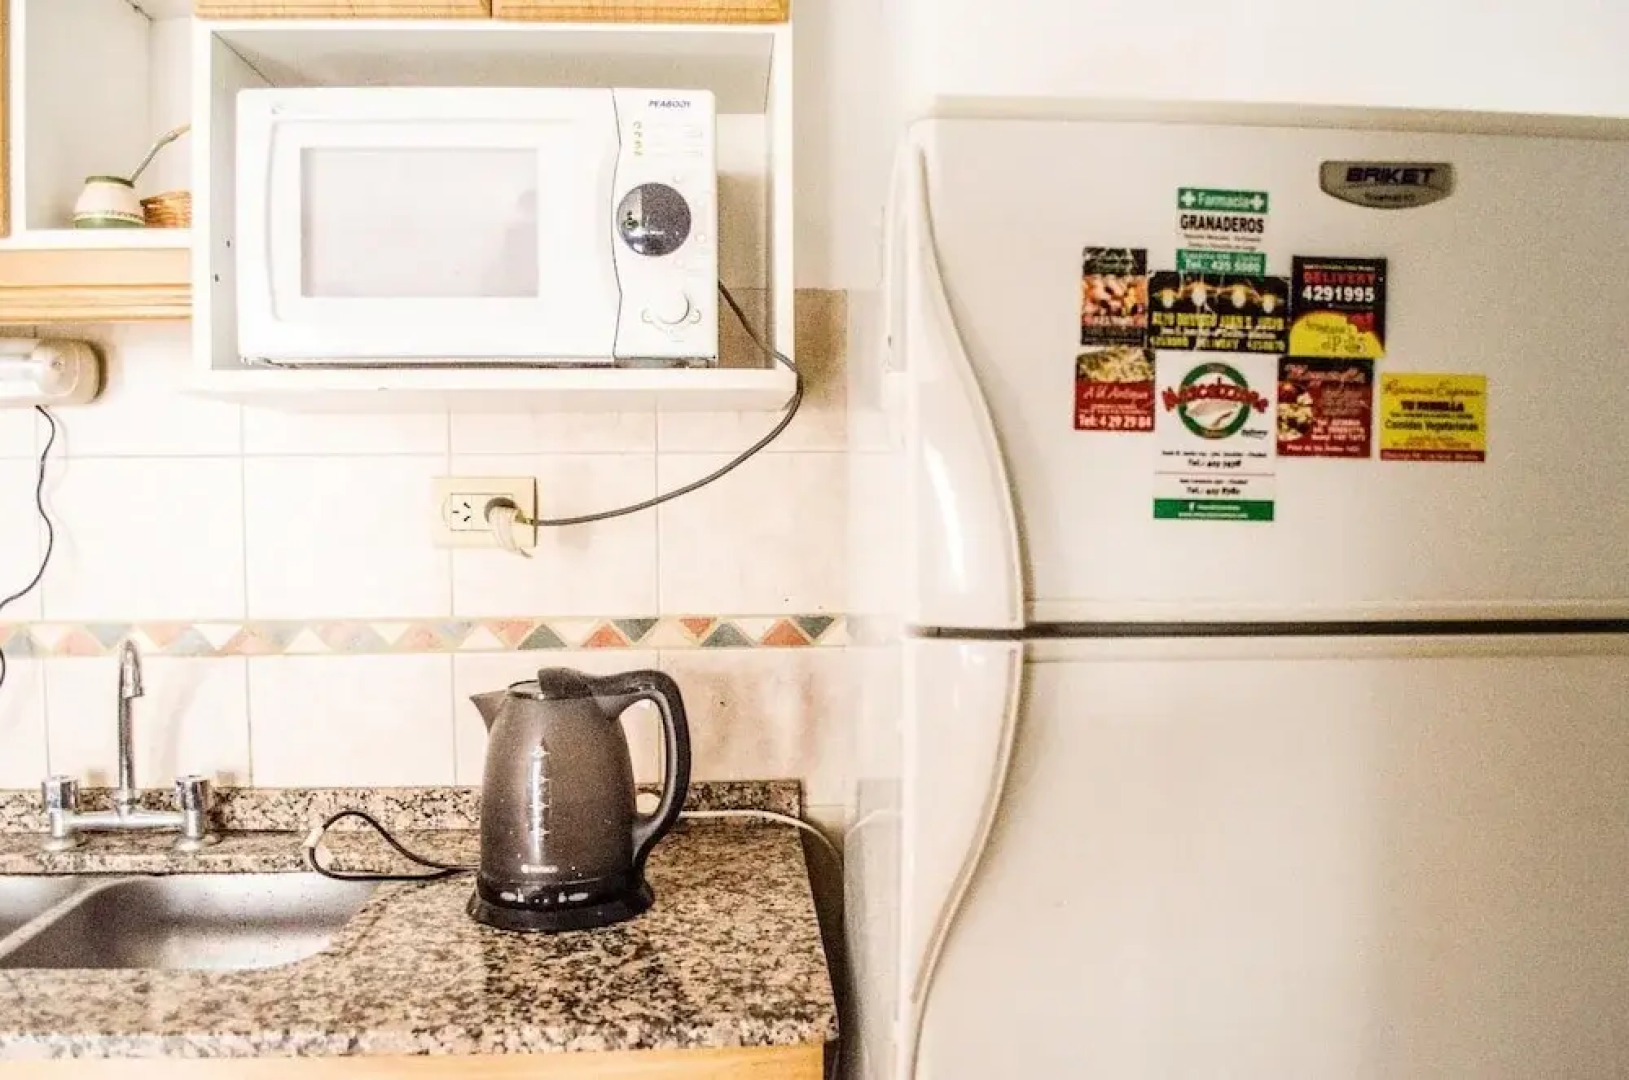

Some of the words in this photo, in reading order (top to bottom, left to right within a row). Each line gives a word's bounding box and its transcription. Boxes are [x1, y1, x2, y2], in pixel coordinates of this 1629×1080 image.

[1346, 167, 1436, 185] BRIKET
[1198, 191, 1249, 208] Farmacia
[1180, 214, 1264, 233] GRANADEROS
[1303, 271, 1376, 286] DELIVERY
[1302, 285, 1376, 302] 4291995
